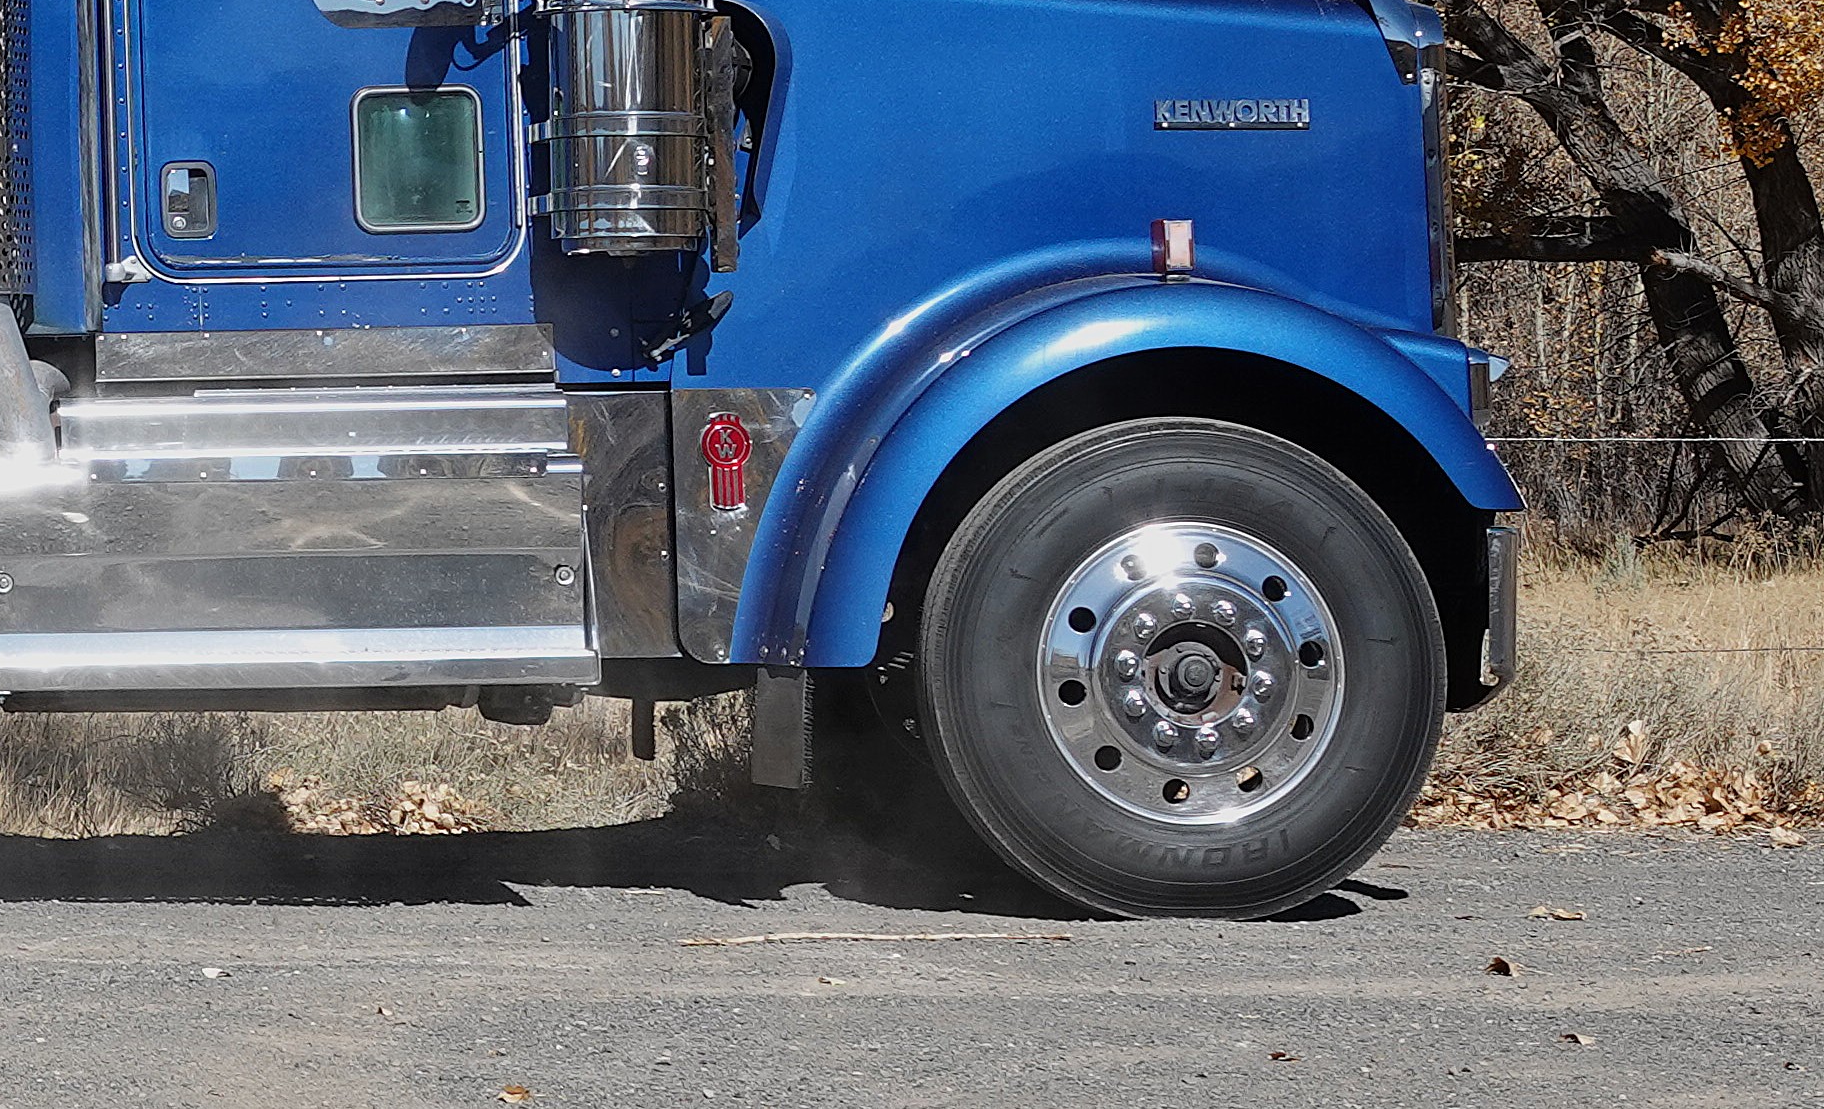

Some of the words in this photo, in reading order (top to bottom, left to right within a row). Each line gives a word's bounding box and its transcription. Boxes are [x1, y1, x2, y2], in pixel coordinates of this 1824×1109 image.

[1154, 99, 1310, 123] KENWORTH
[719, 429, 733, 444] K
[714, 443, 737, 458] W
